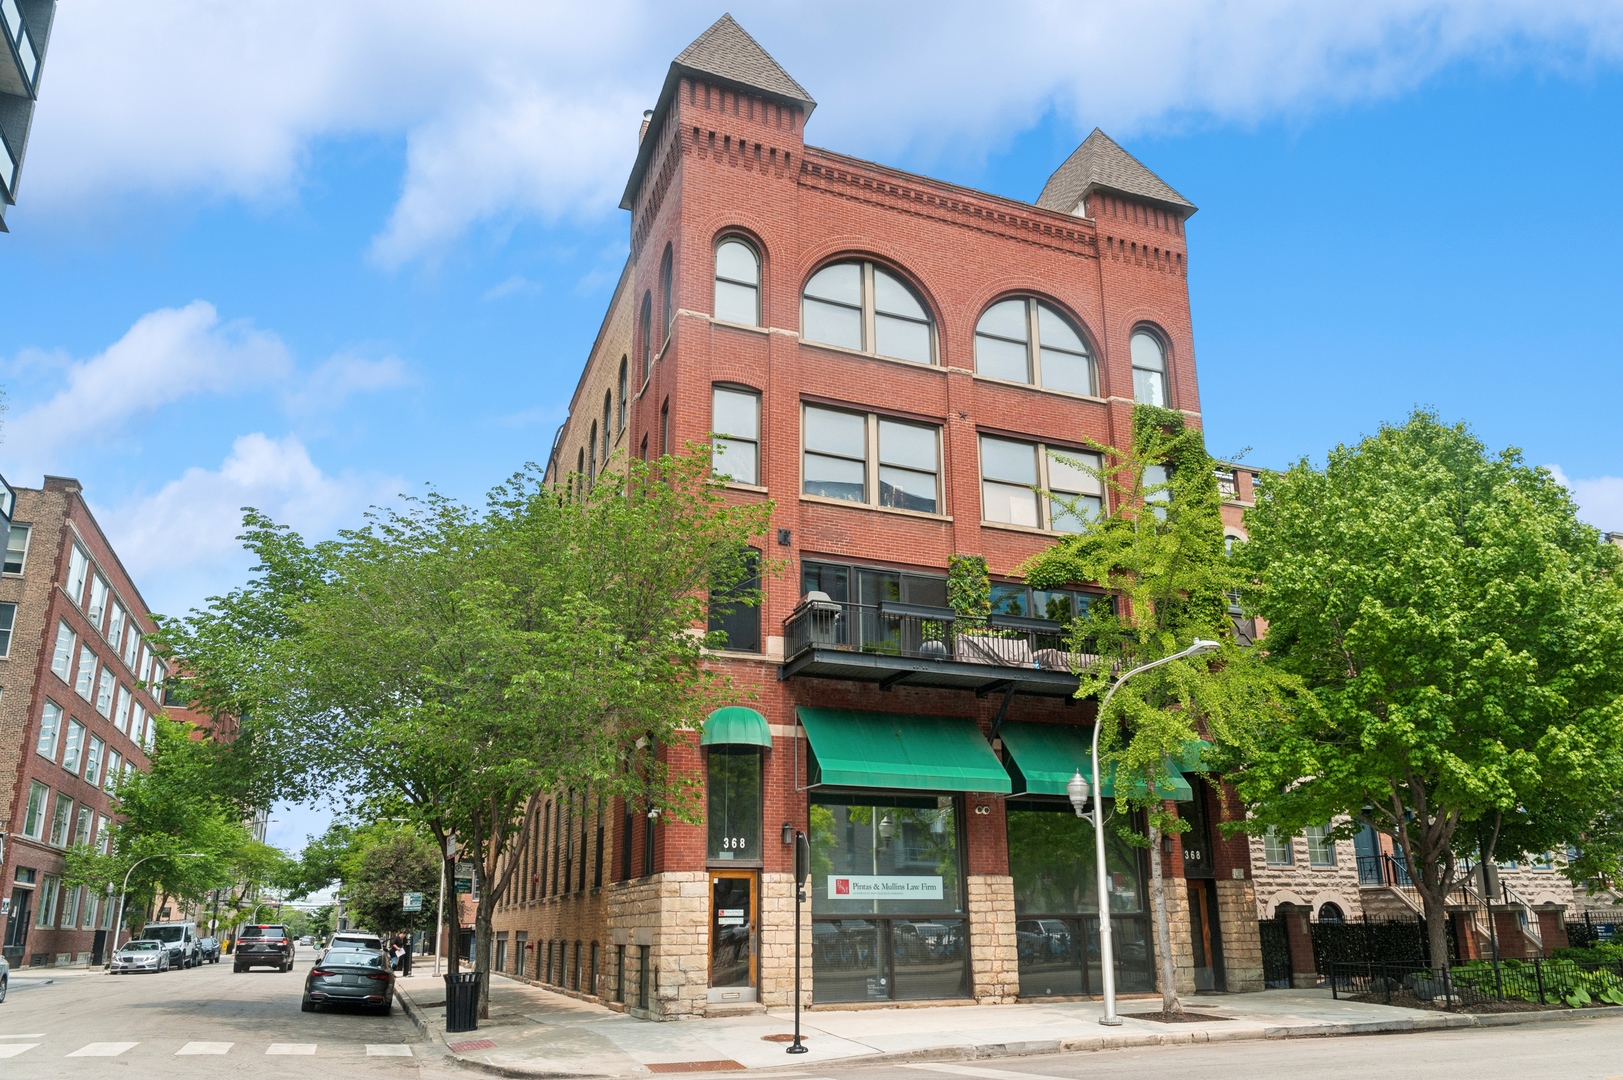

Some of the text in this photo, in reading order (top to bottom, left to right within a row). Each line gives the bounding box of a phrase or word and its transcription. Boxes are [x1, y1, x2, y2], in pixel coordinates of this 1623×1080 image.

[723, 837, 746, 849] 368
[1184, 850, 1201, 860] 368
[852, 882, 937, 891] Pintas & Mullins Law Firm
